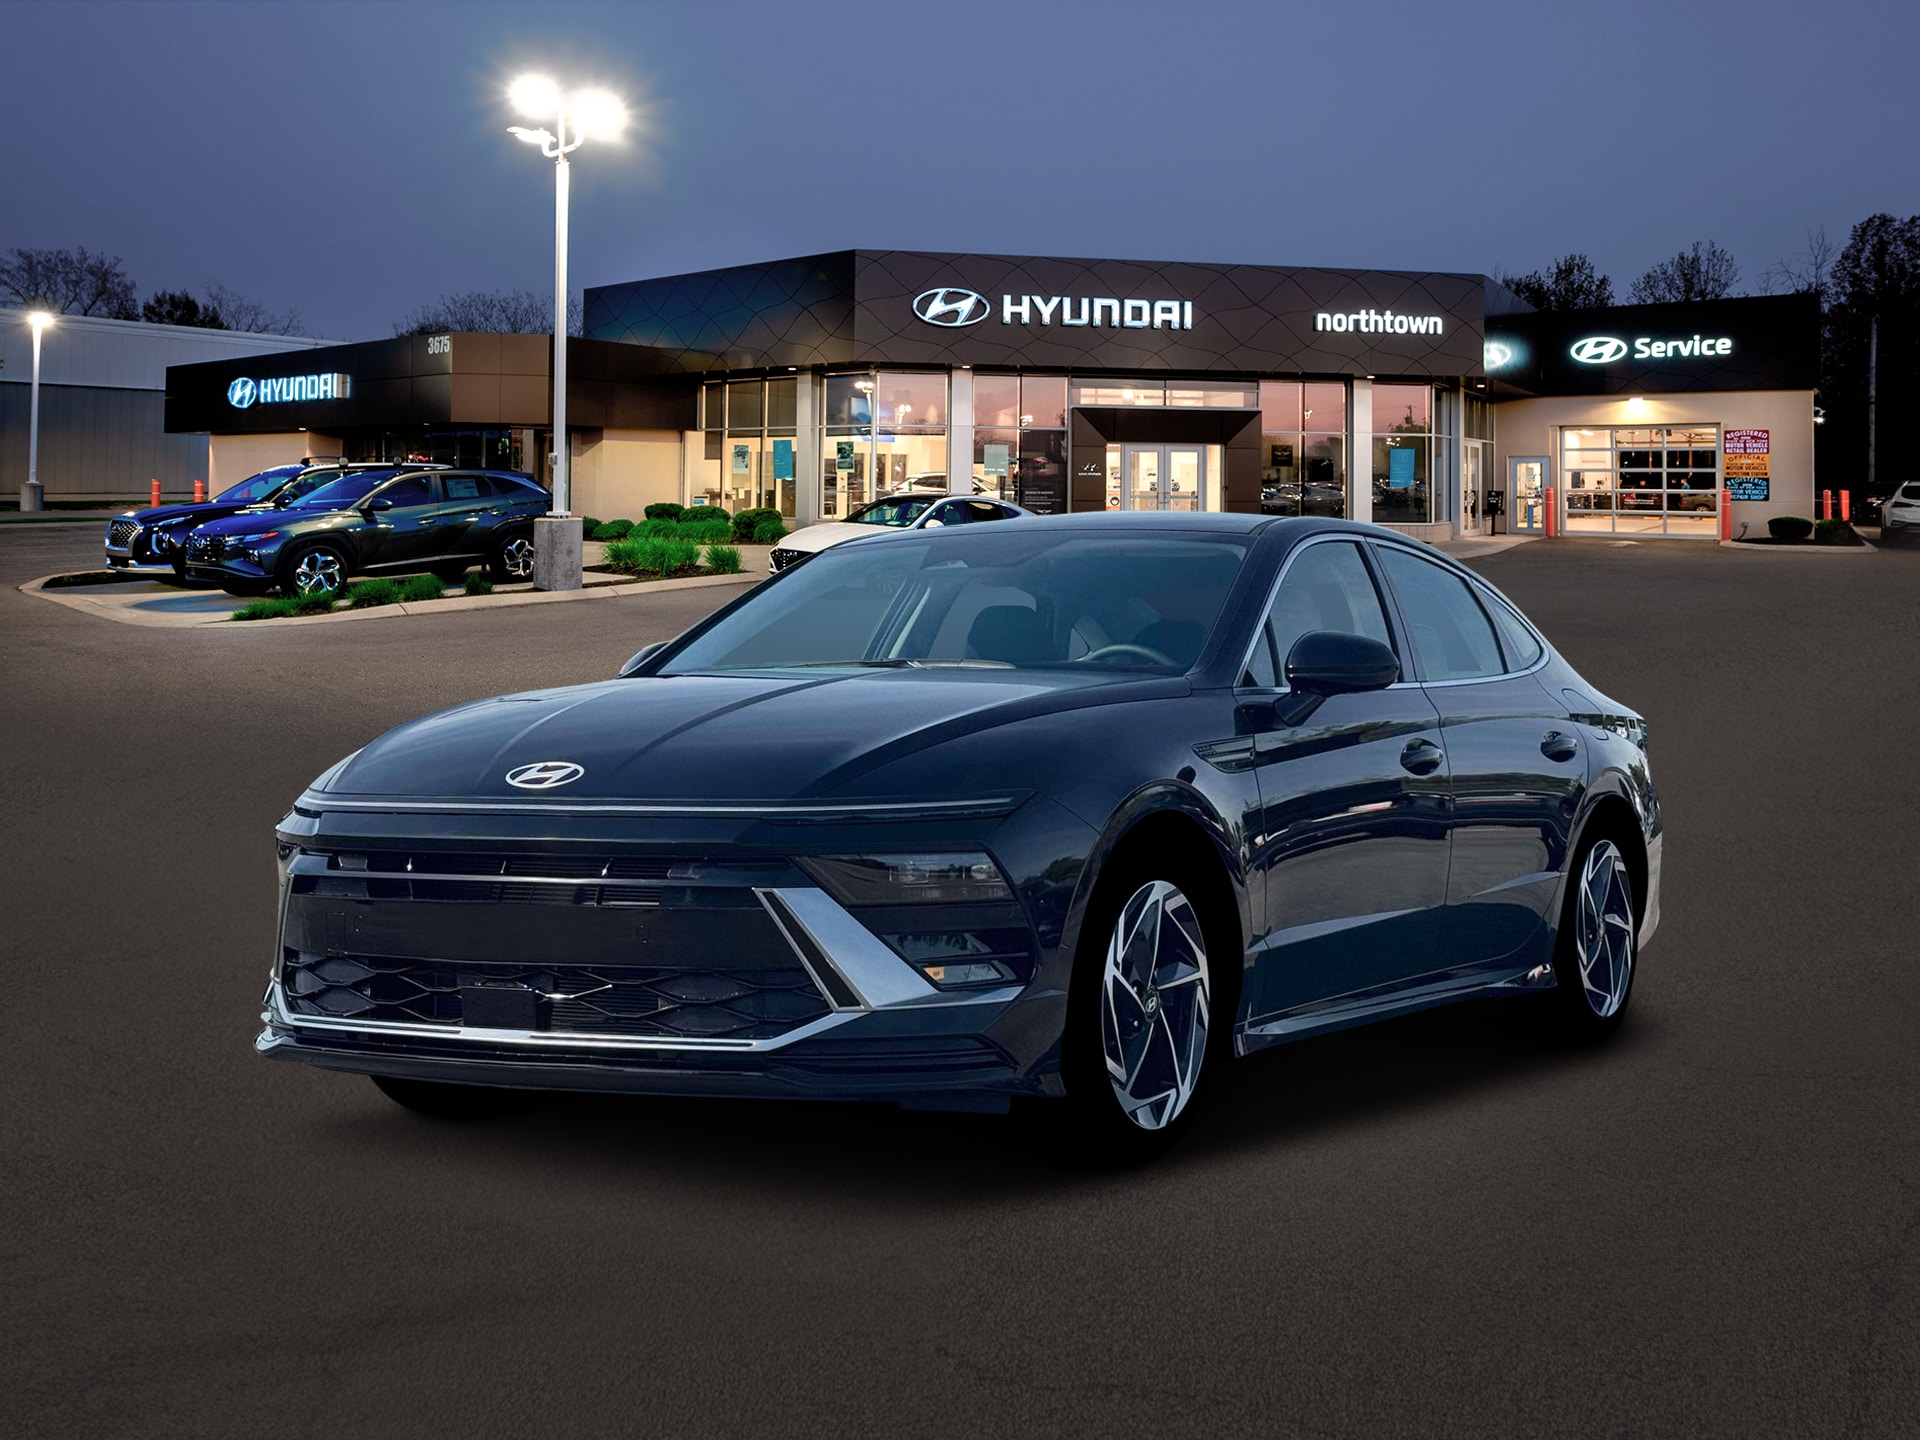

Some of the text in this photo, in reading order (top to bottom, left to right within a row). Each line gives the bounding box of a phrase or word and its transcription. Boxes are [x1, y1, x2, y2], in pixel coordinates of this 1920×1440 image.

[1002, 294, 1193, 330] HYUNDAI
[1316, 309, 1443, 335] northtown
[427, 335, 450, 354] 3675
[1634, 334, 1732, 359] Service
[260, 373, 338, 404] HYUNDAI
[1726, 430, 1768, 439] REGISTERED
[1728, 454, 1765, 462] OFFICIAL
[1726, 477, 1767, 486] REGISTERED
